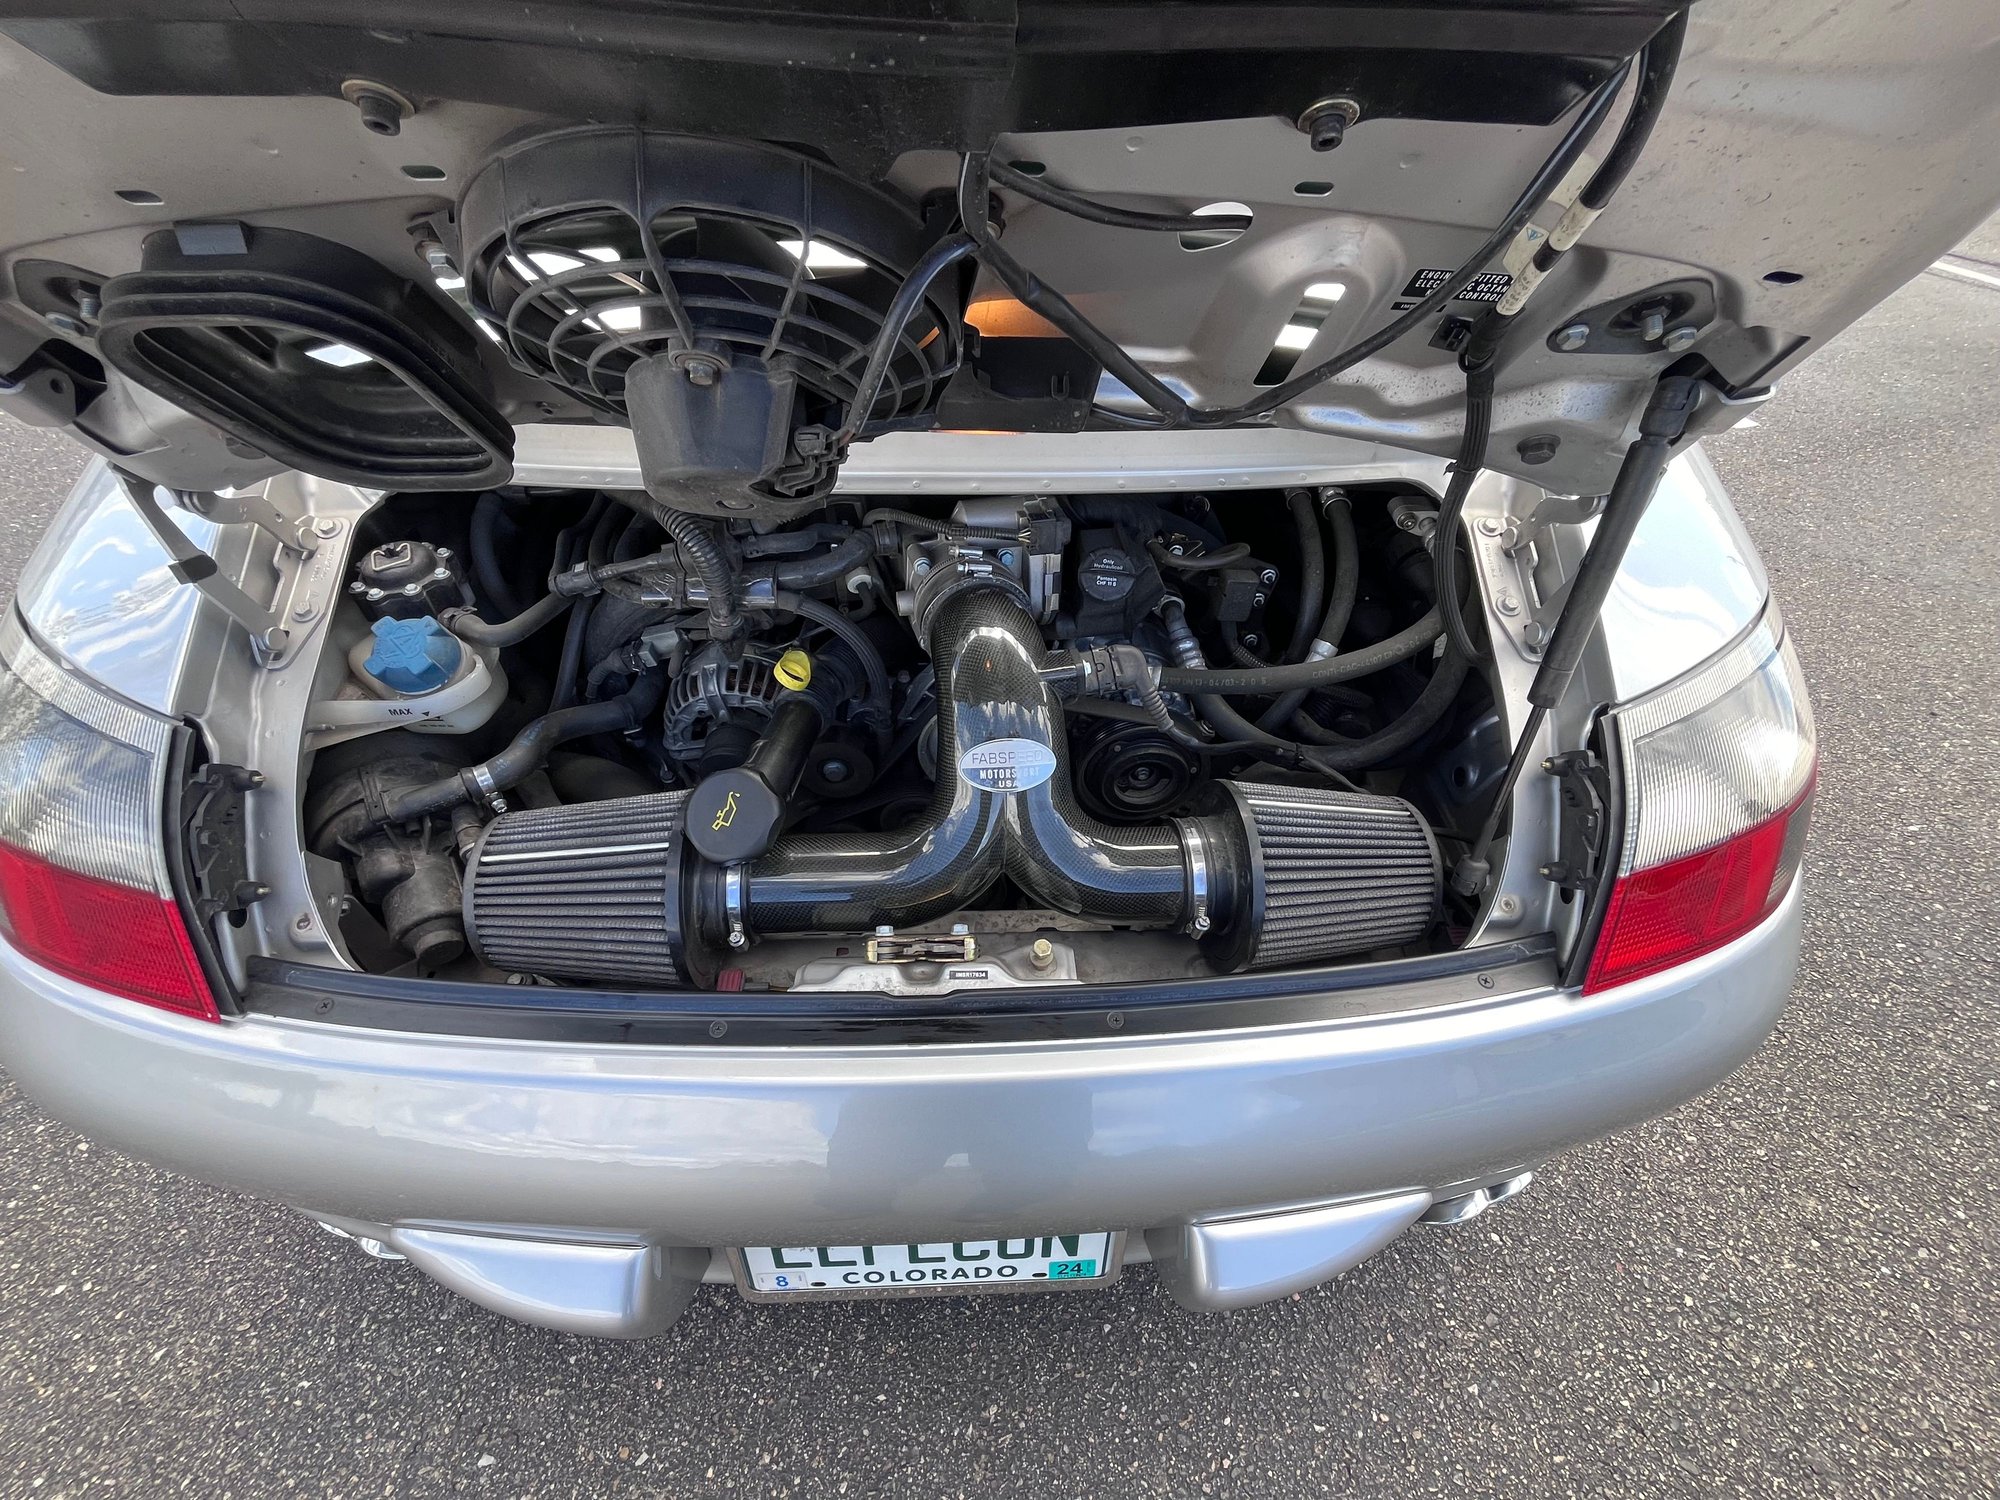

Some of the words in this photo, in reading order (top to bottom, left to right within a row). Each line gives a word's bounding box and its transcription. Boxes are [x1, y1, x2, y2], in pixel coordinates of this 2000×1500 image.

[1420, 270, 1452, 280] ENGIN
[1476, 284, 1511, 293] OCTAN
[1459, 291, 1502, 302] CONTROL
[388, 708, 413, 716] MAX
[972, 750, 1043, 765] FABSPEED
[980, 766, 1040, 780] MOTORSORT
[998, 780, 1018, 788] USA
[842, 1265, 1018, 1284] COLORADO
[1057, 1263, 1083, 1275] 24
[775, 1275, 789, 1287] 8
